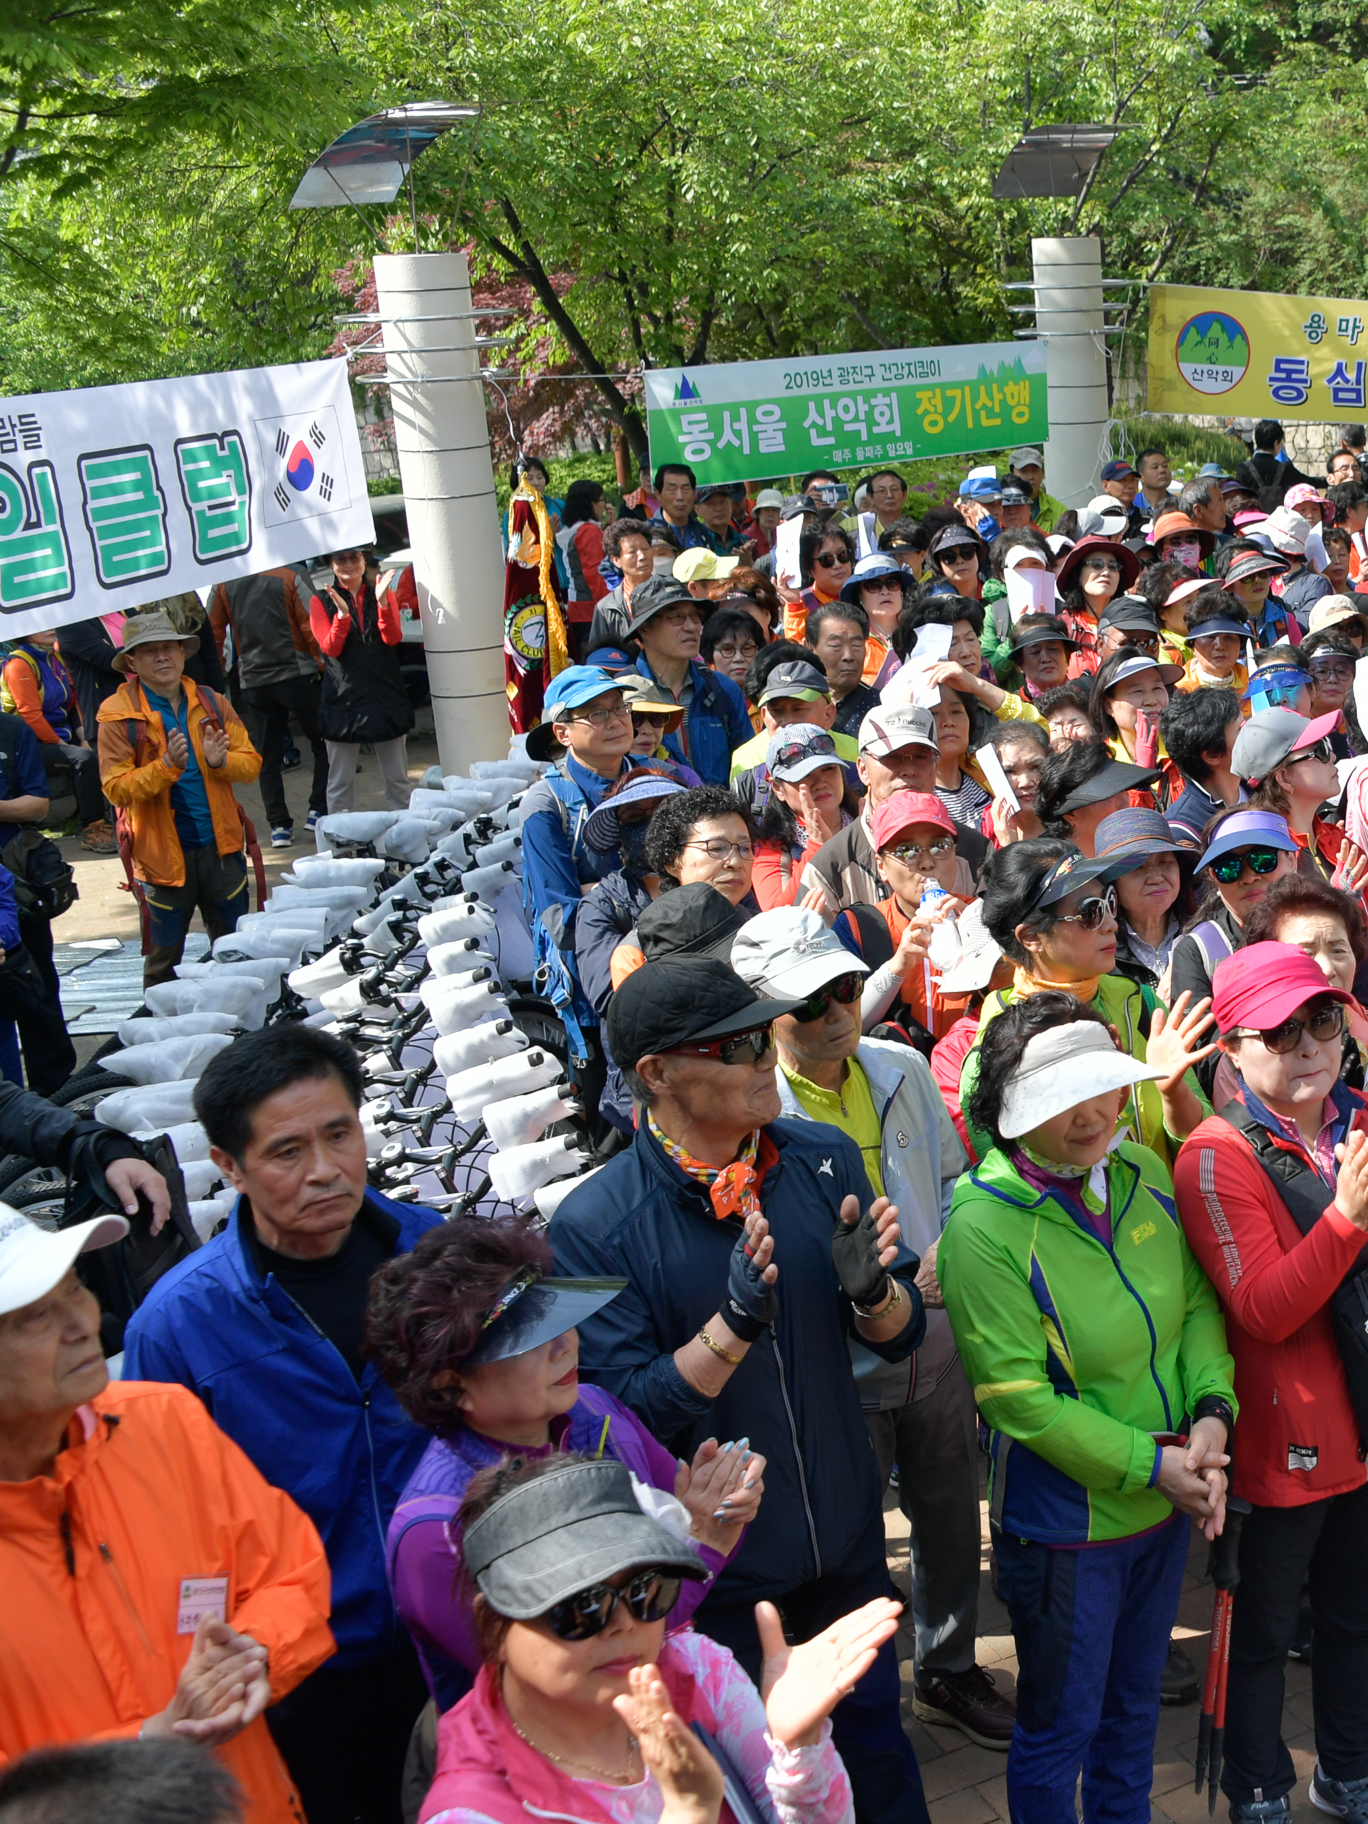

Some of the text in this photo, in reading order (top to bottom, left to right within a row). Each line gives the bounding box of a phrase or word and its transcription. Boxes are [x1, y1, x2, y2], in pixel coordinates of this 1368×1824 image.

[783, 359, 942, 390] 2019년 광진구 건강지킴이
[1190, 367, 1234, 384] 산악회
[677, 379, 1032, 463] 동서울 산악회 정기산행
[832, 450, 853, 464] 매주
[886, 440, 914, 458] 일요일
